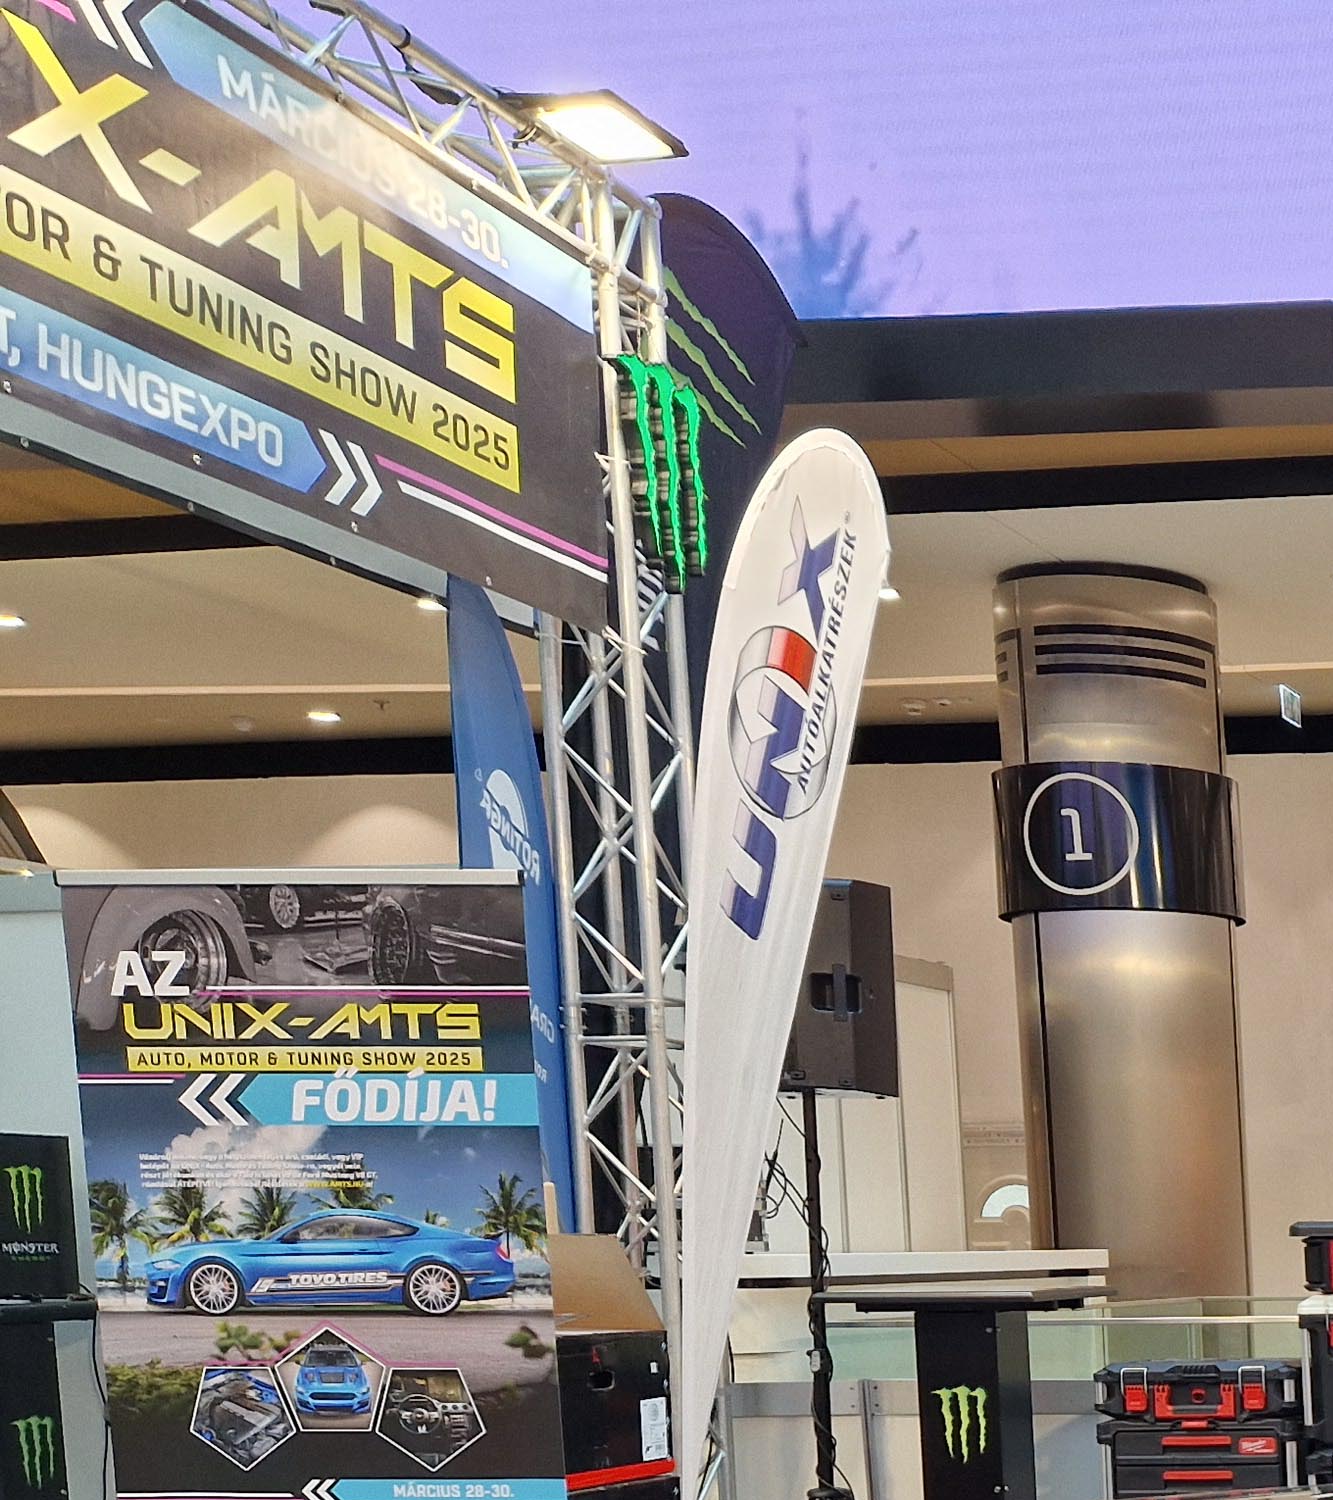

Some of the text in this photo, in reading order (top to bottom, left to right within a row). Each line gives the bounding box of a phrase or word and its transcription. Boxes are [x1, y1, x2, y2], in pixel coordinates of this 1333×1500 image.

[0, 190, 510, 472] OR & TUNING SHOW 2025
[38, 321, 285, 468] HUNGEXPO
[1060, 808, 1093, 861] 1
[111, 950, 190, 997] AZ
[122, 1001, 483, 1041] UNIX-AMTS
[137, 1051, 472, 1069] AUTO, MOTOR & TUNING SHOW 2025
[291, 1066, 497, 1122] FŐDÍJA!
[2, 1241, 60, 1255] MONSTER
[289, 1271, 389, 1286] TOYO TIRES
[393, 1481, 515, 1498] MÁRCIUS 28-30.
